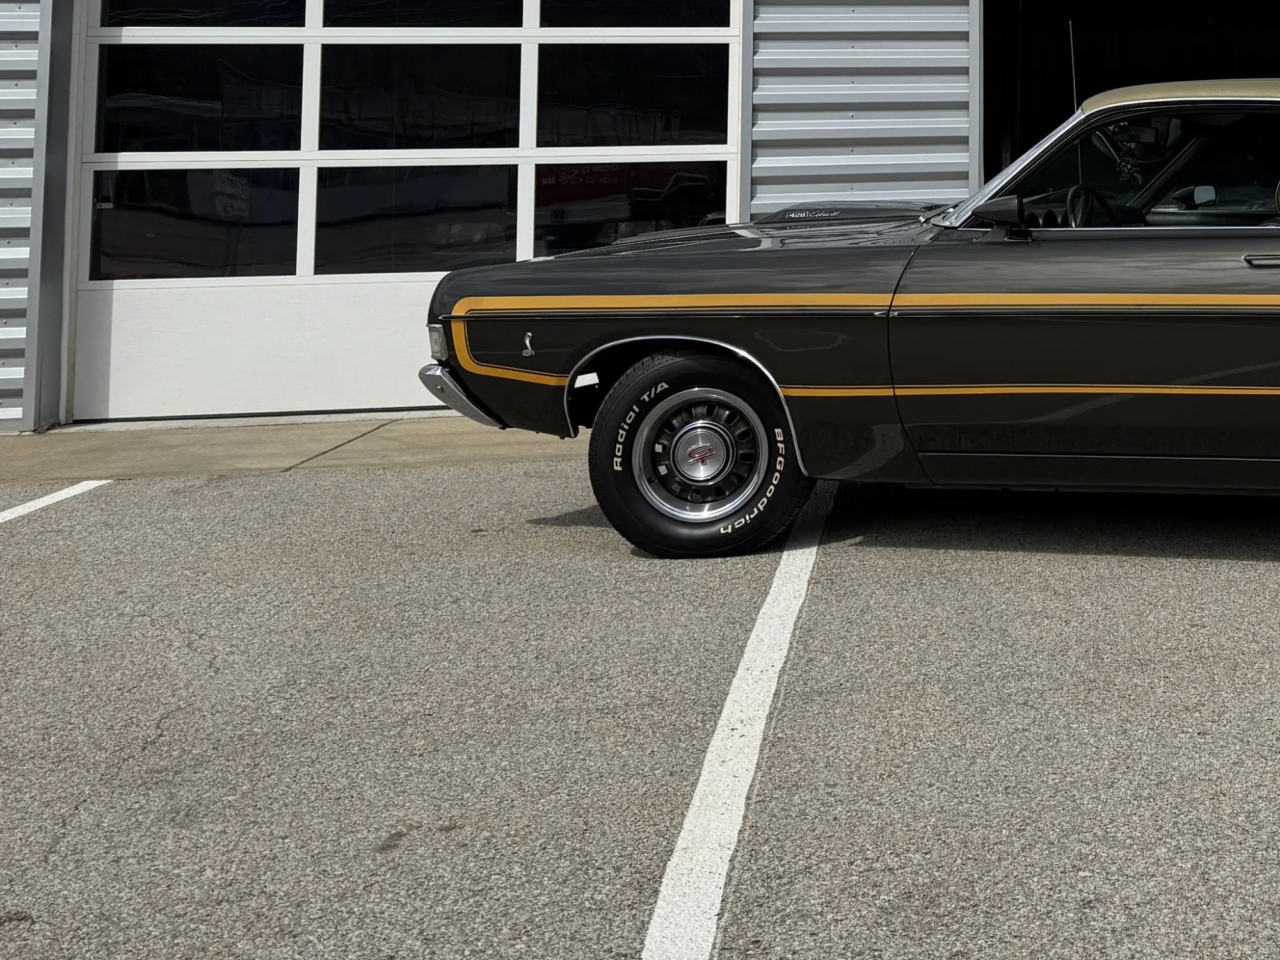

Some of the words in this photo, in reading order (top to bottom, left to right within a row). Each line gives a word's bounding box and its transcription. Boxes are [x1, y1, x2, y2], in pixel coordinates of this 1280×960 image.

[612, 404, 640, 471] Radial
[640, 381, 670, 403] T/A
[719, 427, 785, 535] BFGoodrich
